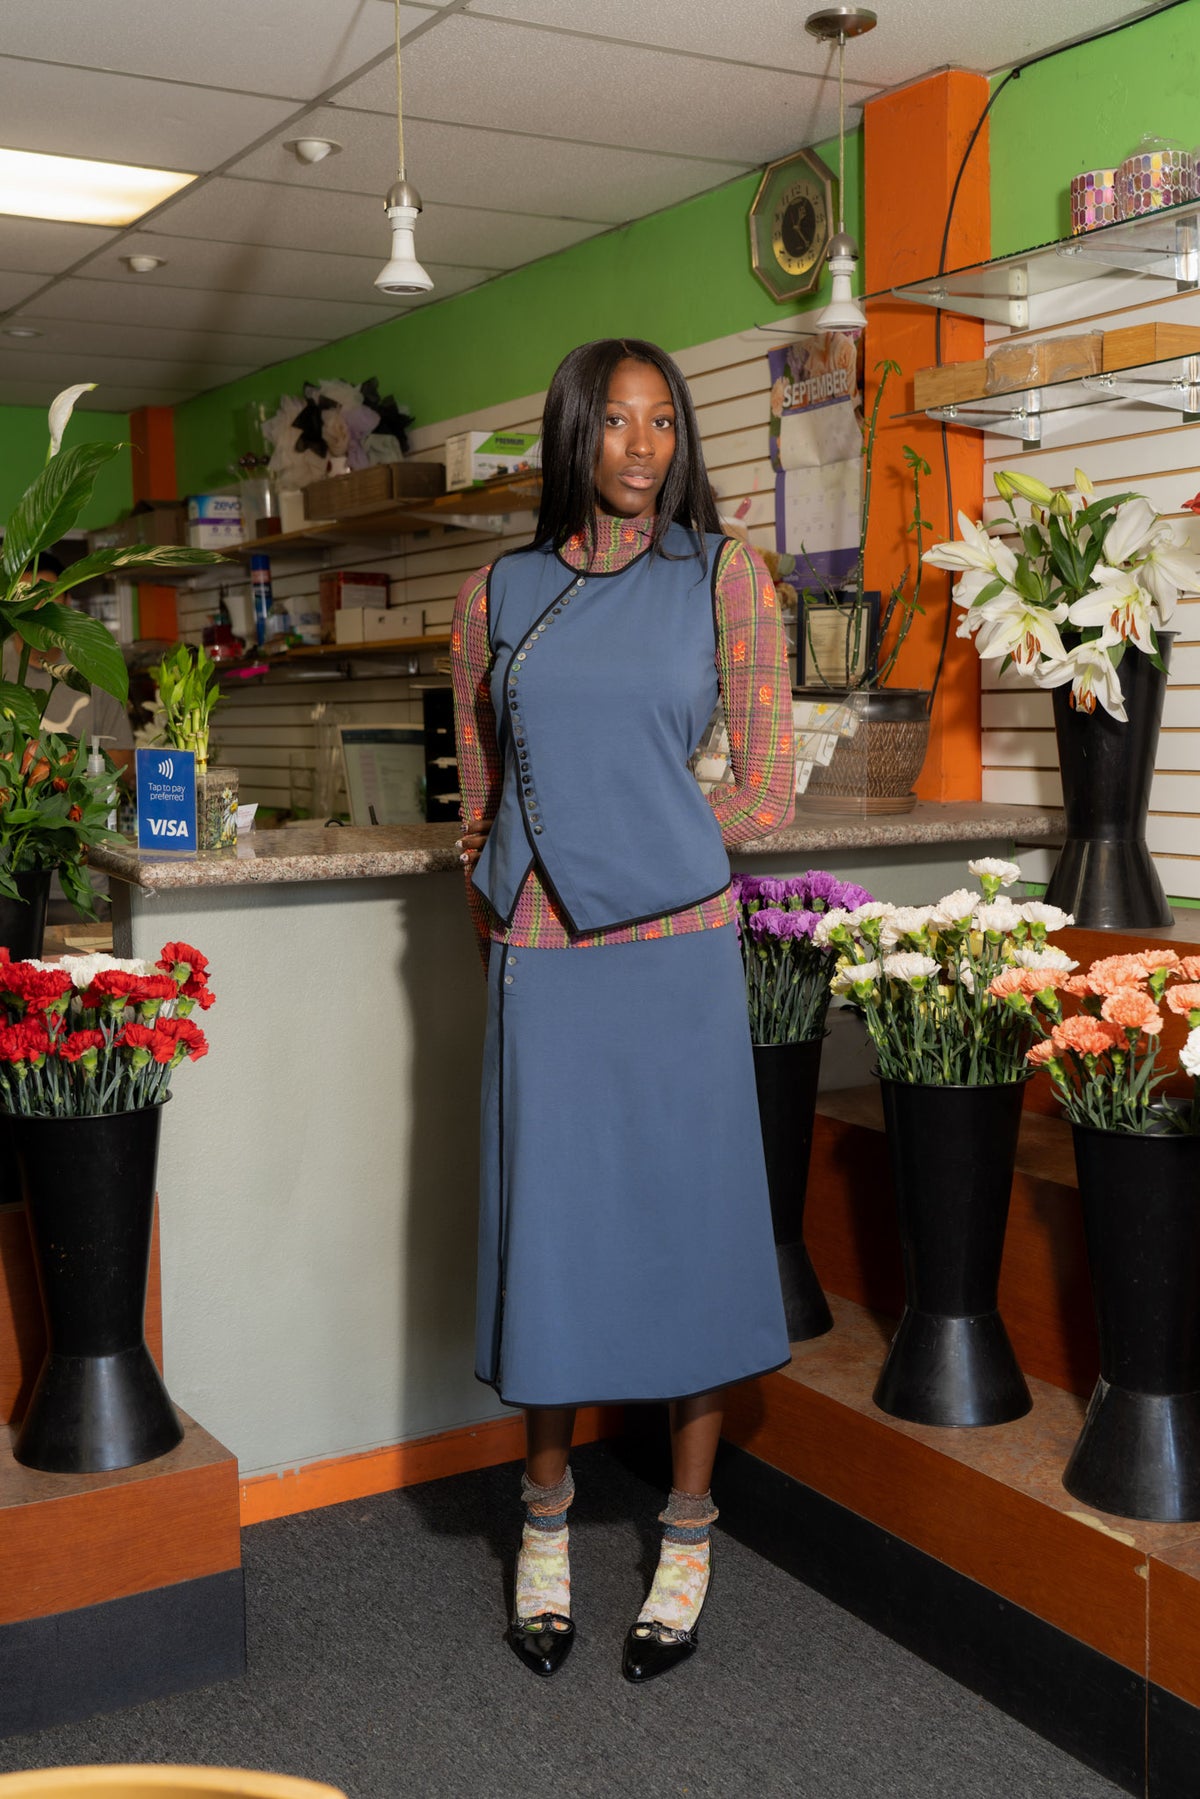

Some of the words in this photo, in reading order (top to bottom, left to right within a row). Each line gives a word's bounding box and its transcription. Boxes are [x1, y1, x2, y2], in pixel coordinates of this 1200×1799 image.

[791, 184, 801, 197] 12
[782, 369, 849, 408] SEPTEMBER
[148, 782, 162, 792] Tap
[162, 784, 171, 792] to
[171, 785, 186, 794] pay
[150, 792, 184, 802] preferred
[146, 818, 189, 838] VISA
